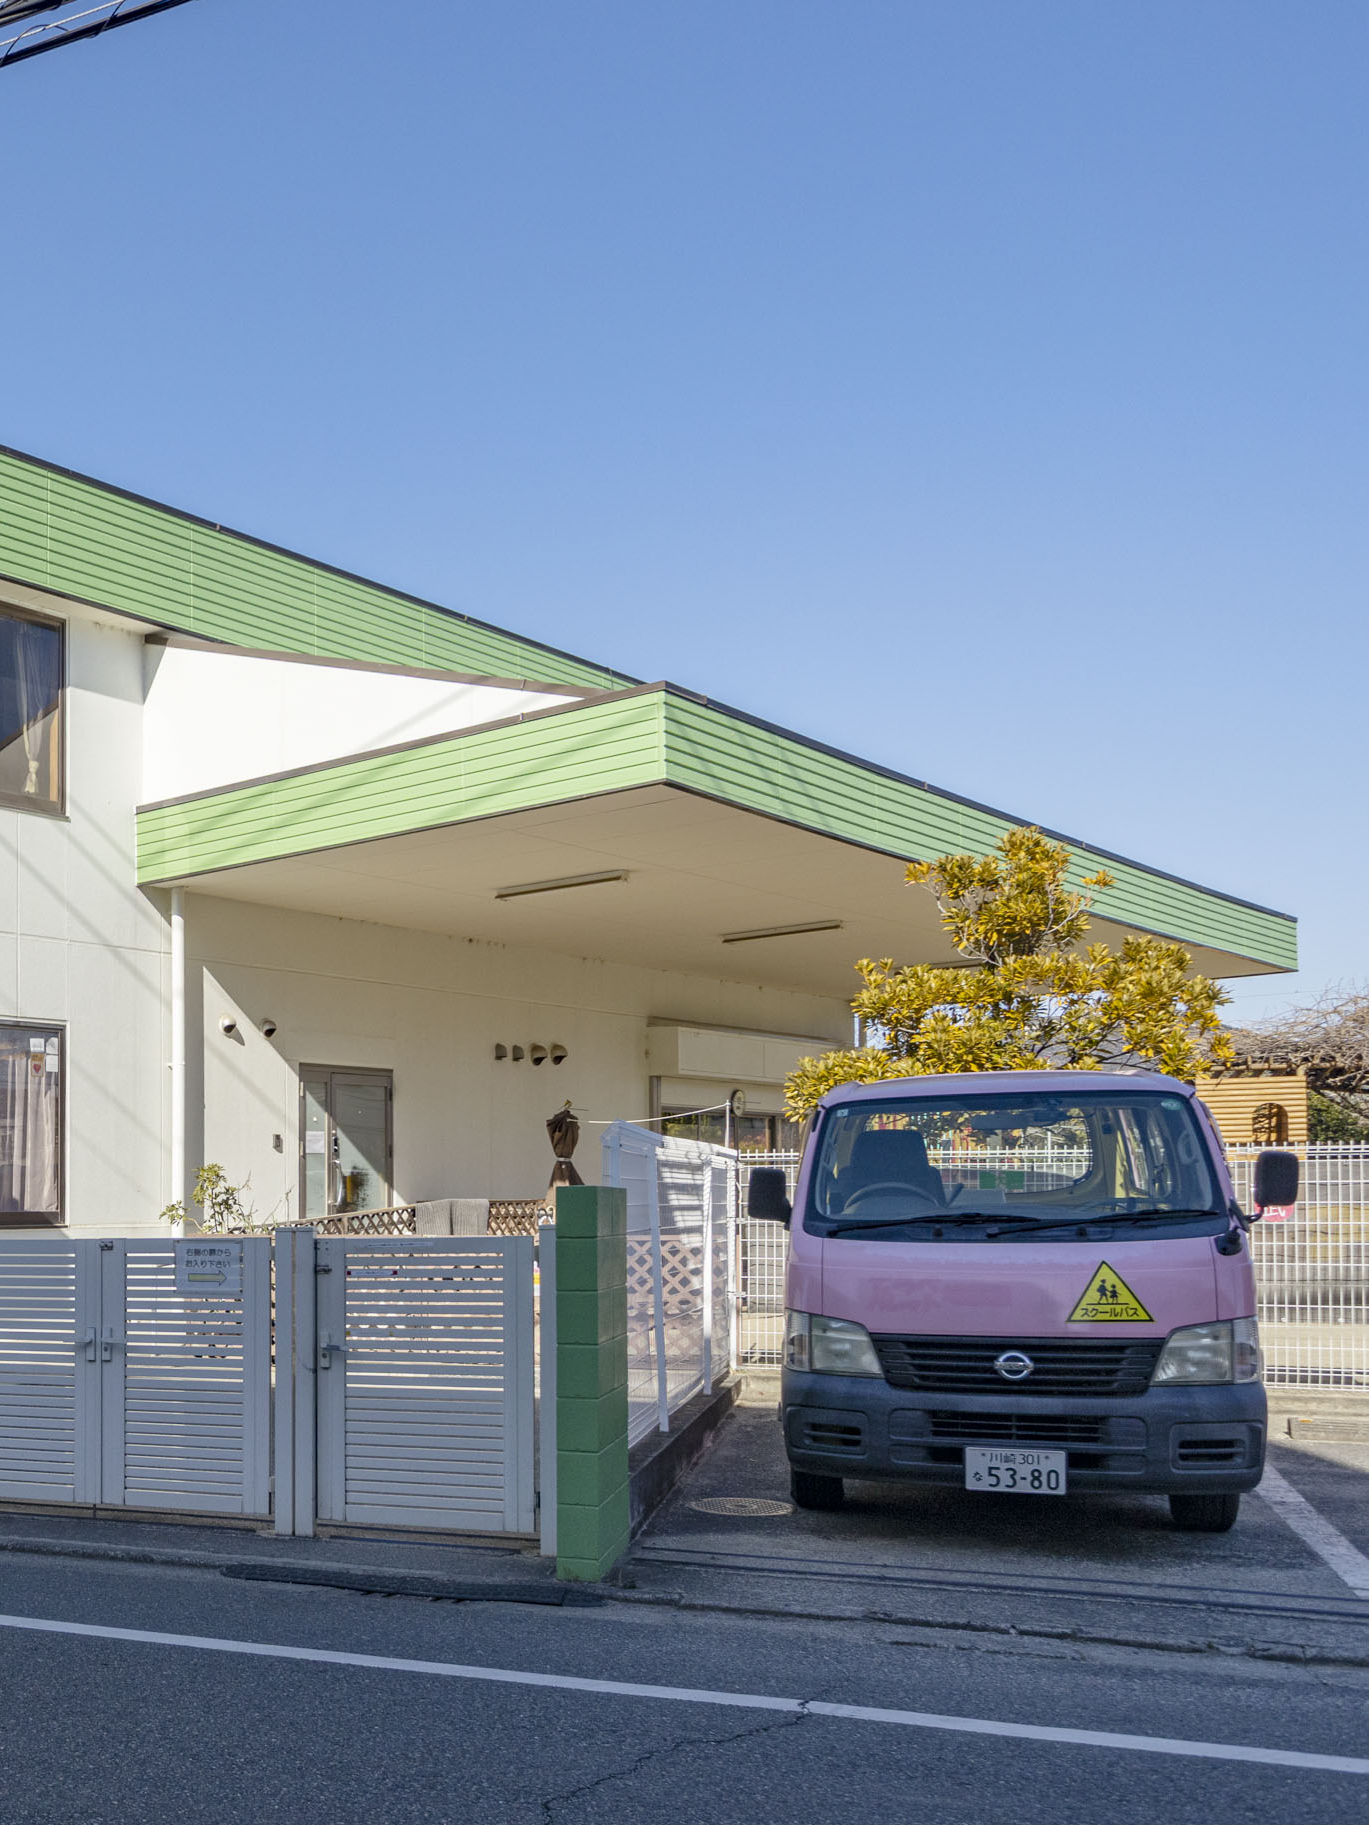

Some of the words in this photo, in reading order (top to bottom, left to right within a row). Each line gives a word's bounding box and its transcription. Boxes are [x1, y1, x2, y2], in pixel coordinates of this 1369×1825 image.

[1080, 1306, 1140, 1318] スクールバス
[987, 1466, 1060, 1491] 53-80
